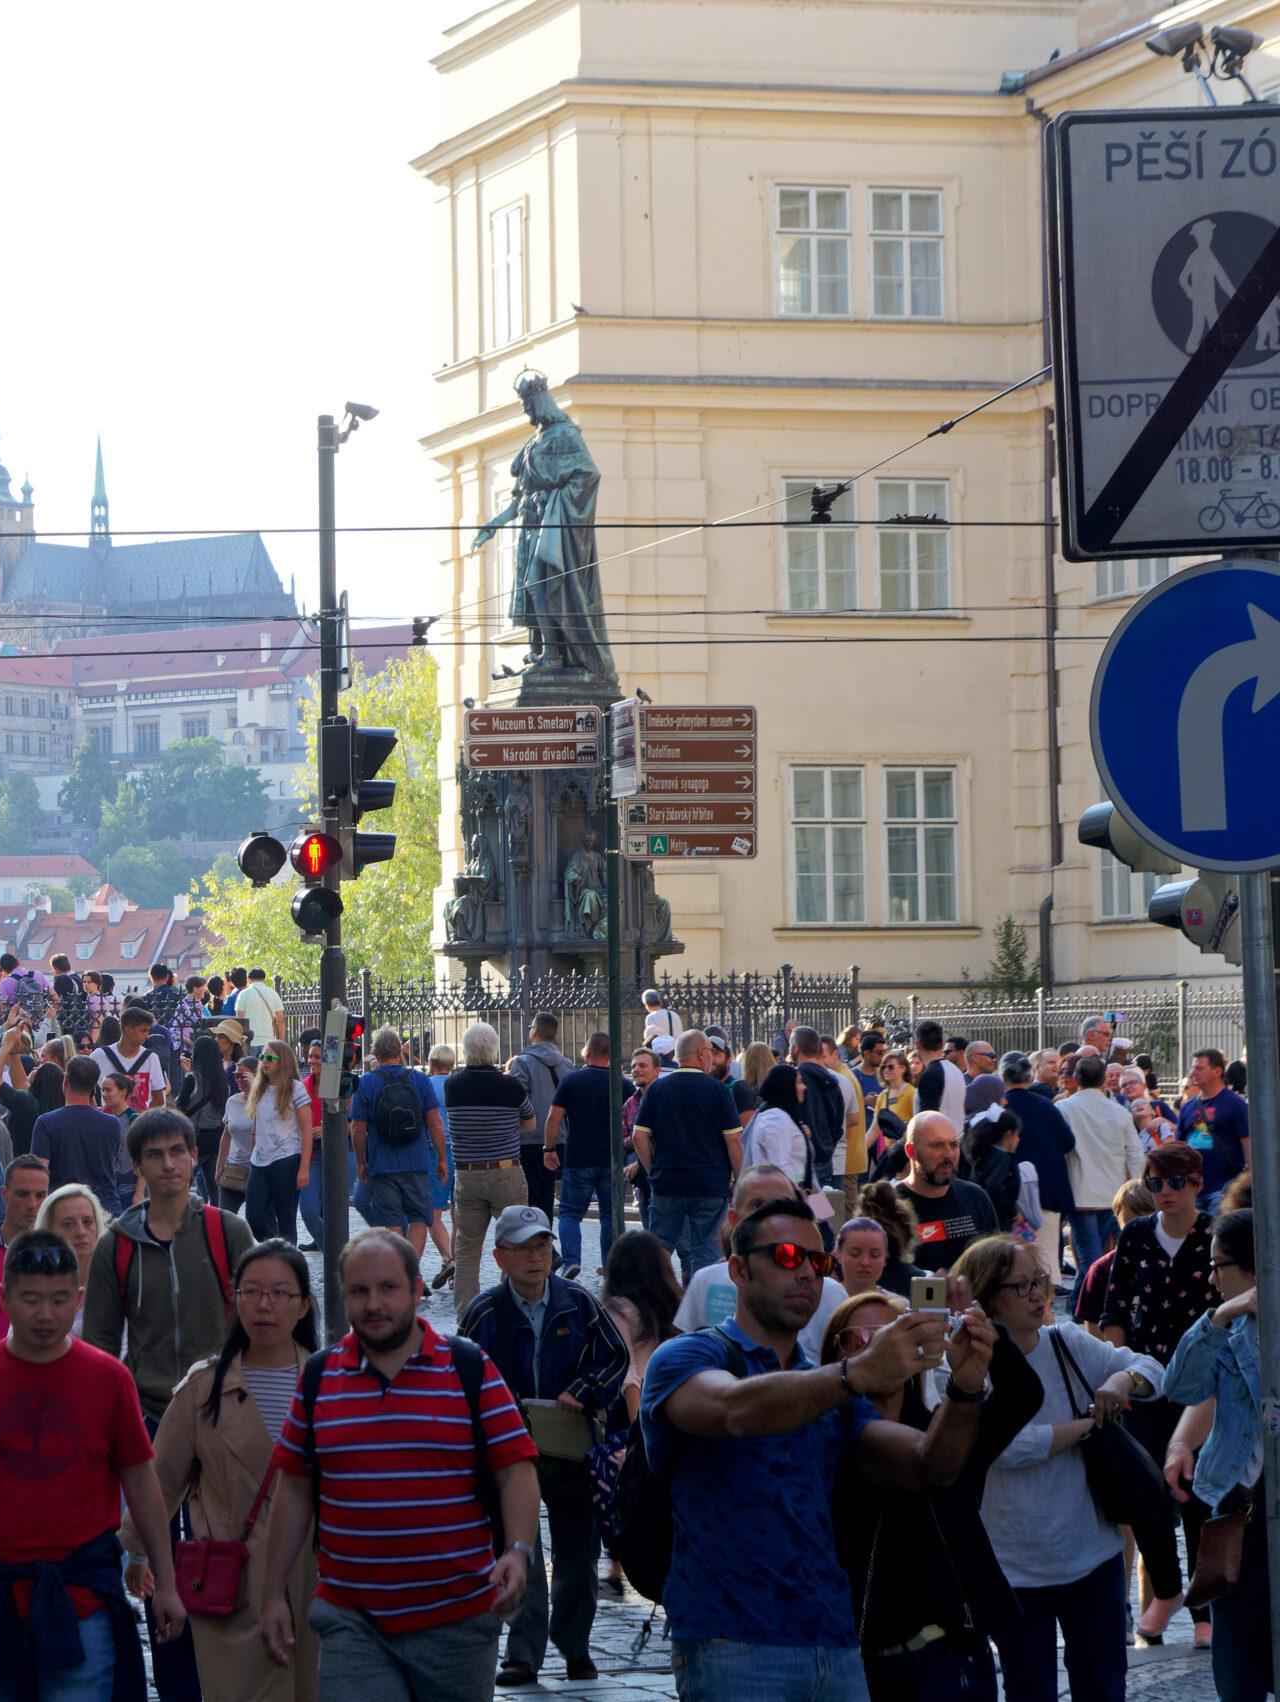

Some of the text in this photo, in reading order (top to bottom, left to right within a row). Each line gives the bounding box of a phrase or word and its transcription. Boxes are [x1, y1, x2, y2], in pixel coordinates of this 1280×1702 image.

[1105, 127, 1276, 182] PĚŠÍ ZÓ
[1175, 456, 1232, 484] 18.00
[491, 715, 574, 732] Muzeum B. Smetany
[502, 746, 575, 762] Národní divadlo
[647, 744, 681, 759] Rudolfinum
[648, 776, 679, 790] Staronová
[680, 778, 710, 793] synagoga
[648, 806, 665, 824] Starý
[653, 837, 665, 852] A
